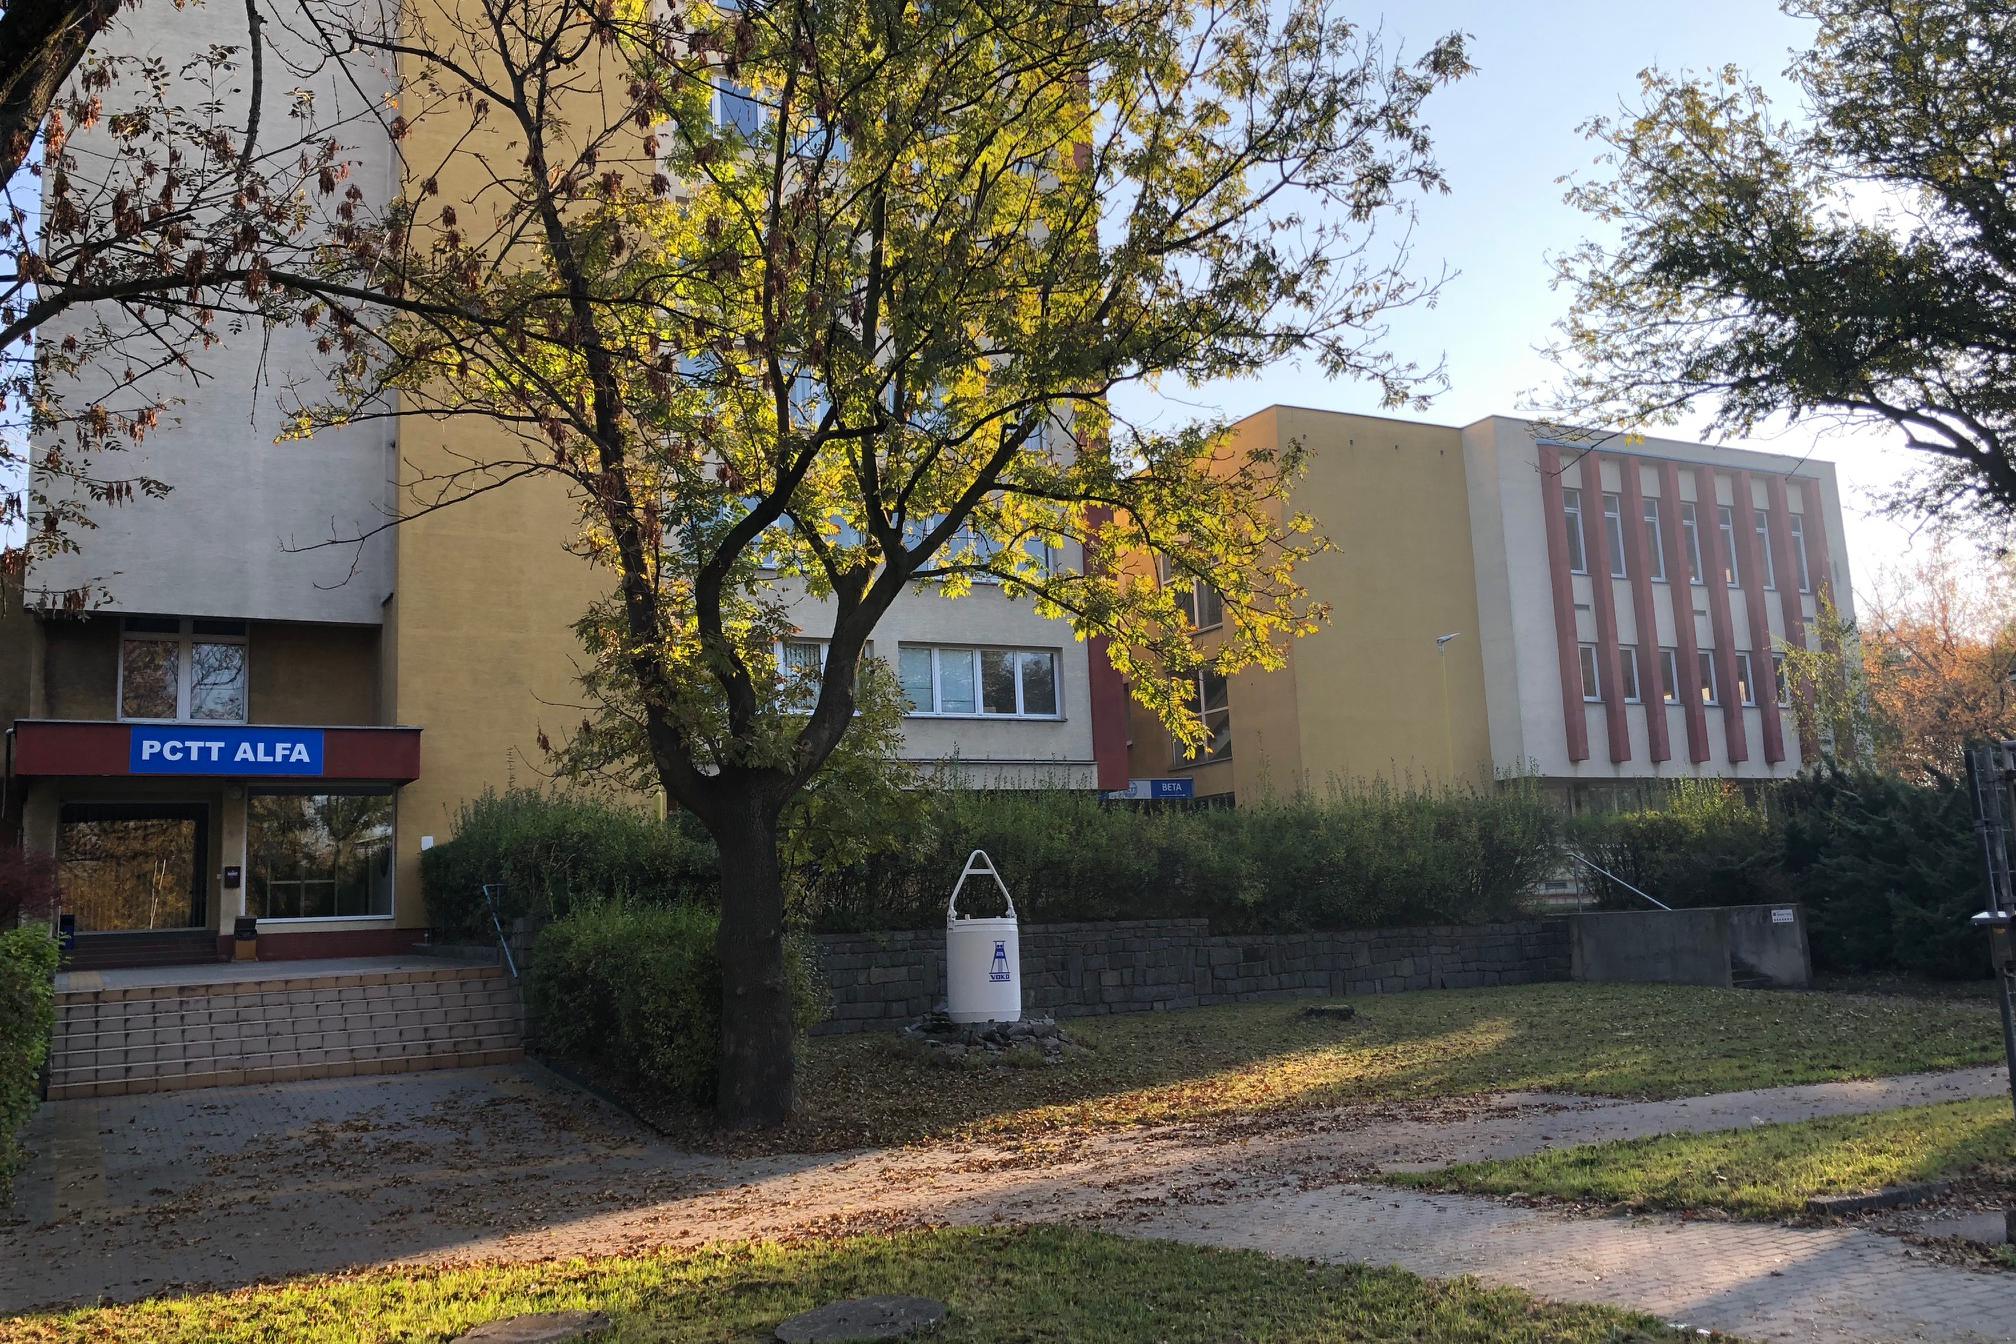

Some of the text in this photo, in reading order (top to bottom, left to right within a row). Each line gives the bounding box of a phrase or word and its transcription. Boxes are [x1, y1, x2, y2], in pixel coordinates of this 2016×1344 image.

[141, 740, 311, 763] PCTT ALFA
[1161, 782, 1183, 792] BETA
